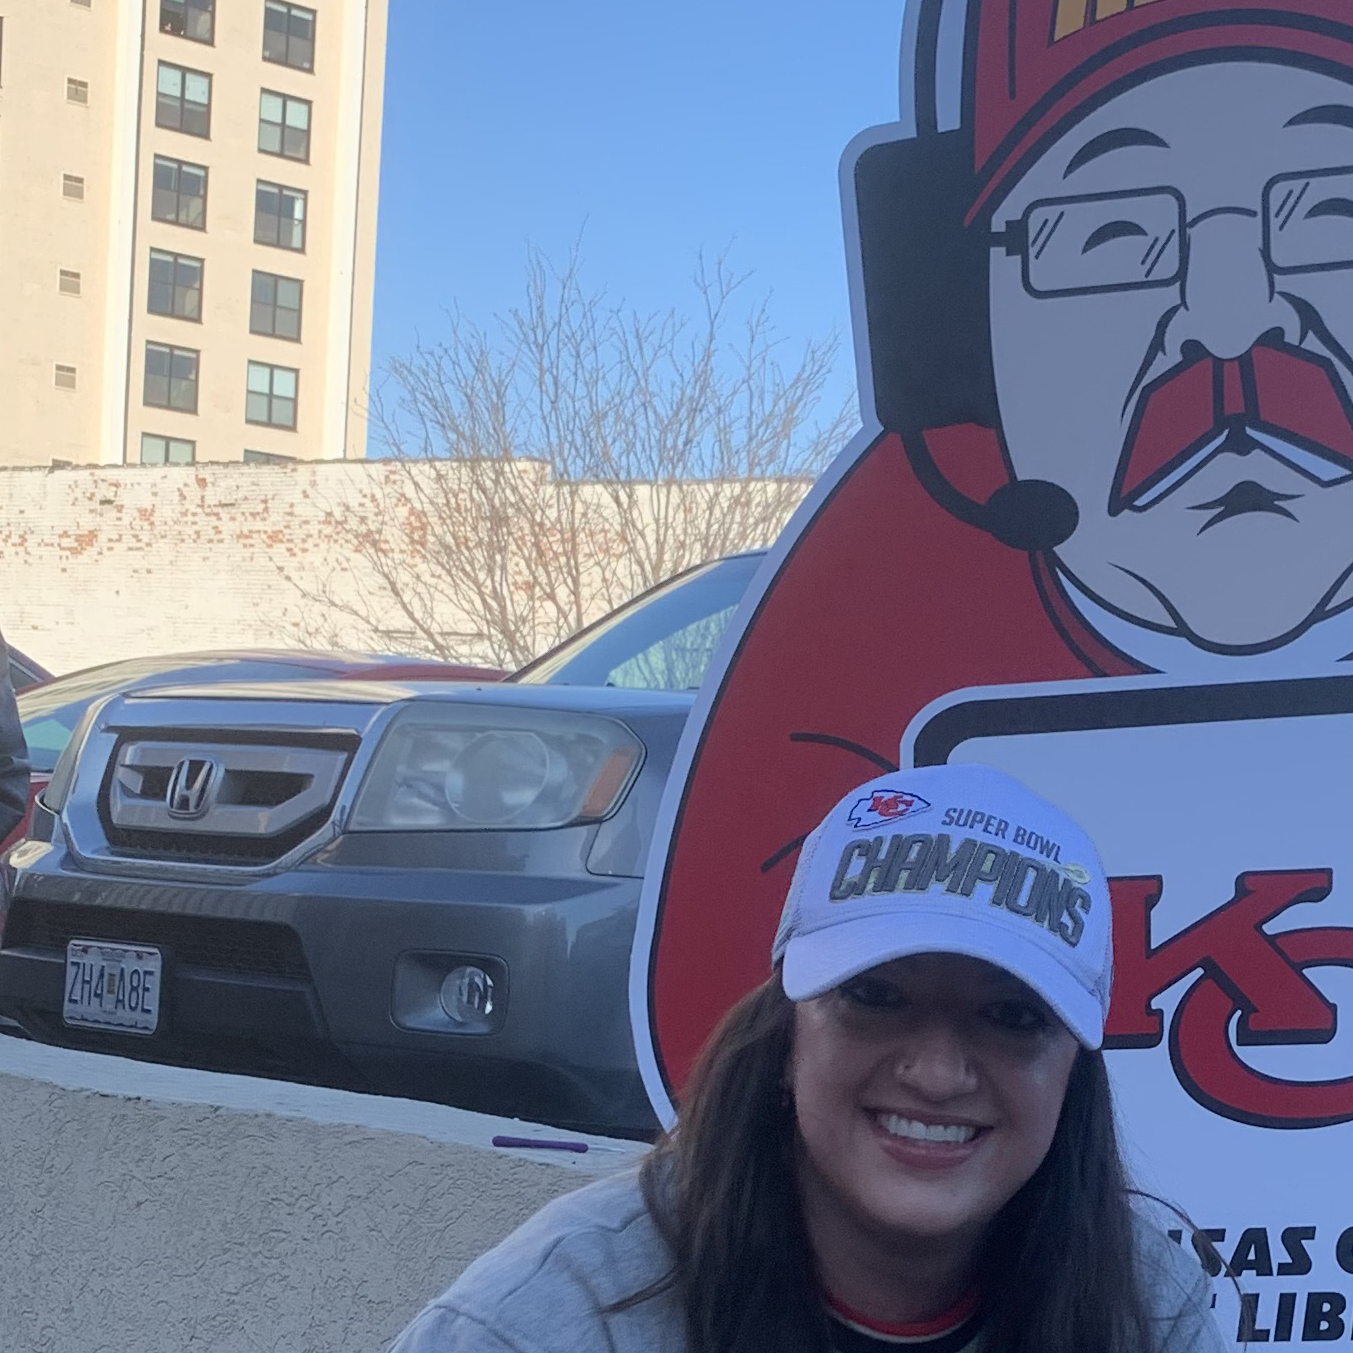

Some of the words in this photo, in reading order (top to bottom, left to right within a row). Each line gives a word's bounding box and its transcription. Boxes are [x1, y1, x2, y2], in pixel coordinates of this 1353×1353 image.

[867, 794, 915, 818] KC
[941, 807, 1010, 840] SUPER
[1012, 825, 1061, 864] BOWL
[828, 833, 1093, 949] CHAMPIONS
[68, 960, 105, 1008] ZH4
[114, 966, 155, 1014] A8E
[1168, 1226, 1316, 1277] SAS
